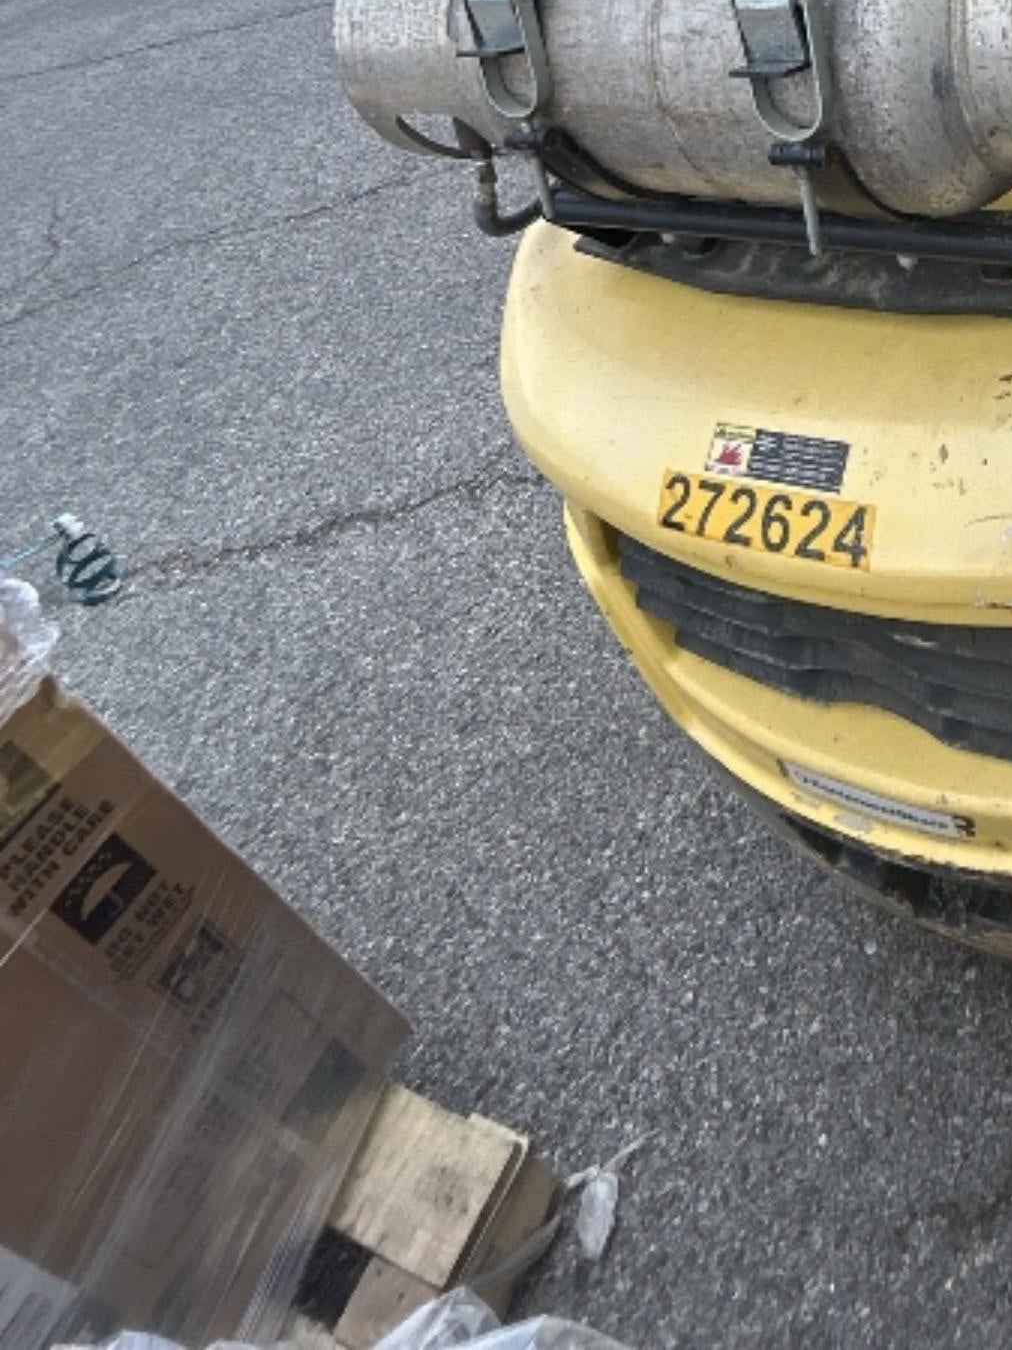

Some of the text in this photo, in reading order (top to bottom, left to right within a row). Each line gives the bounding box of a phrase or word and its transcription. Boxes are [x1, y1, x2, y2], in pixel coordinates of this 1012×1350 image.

[661, 472, 868, 568] 272624
[0, 798, 80, 881] PLEASE
[10, 799, 115, 917] WITH CARE
